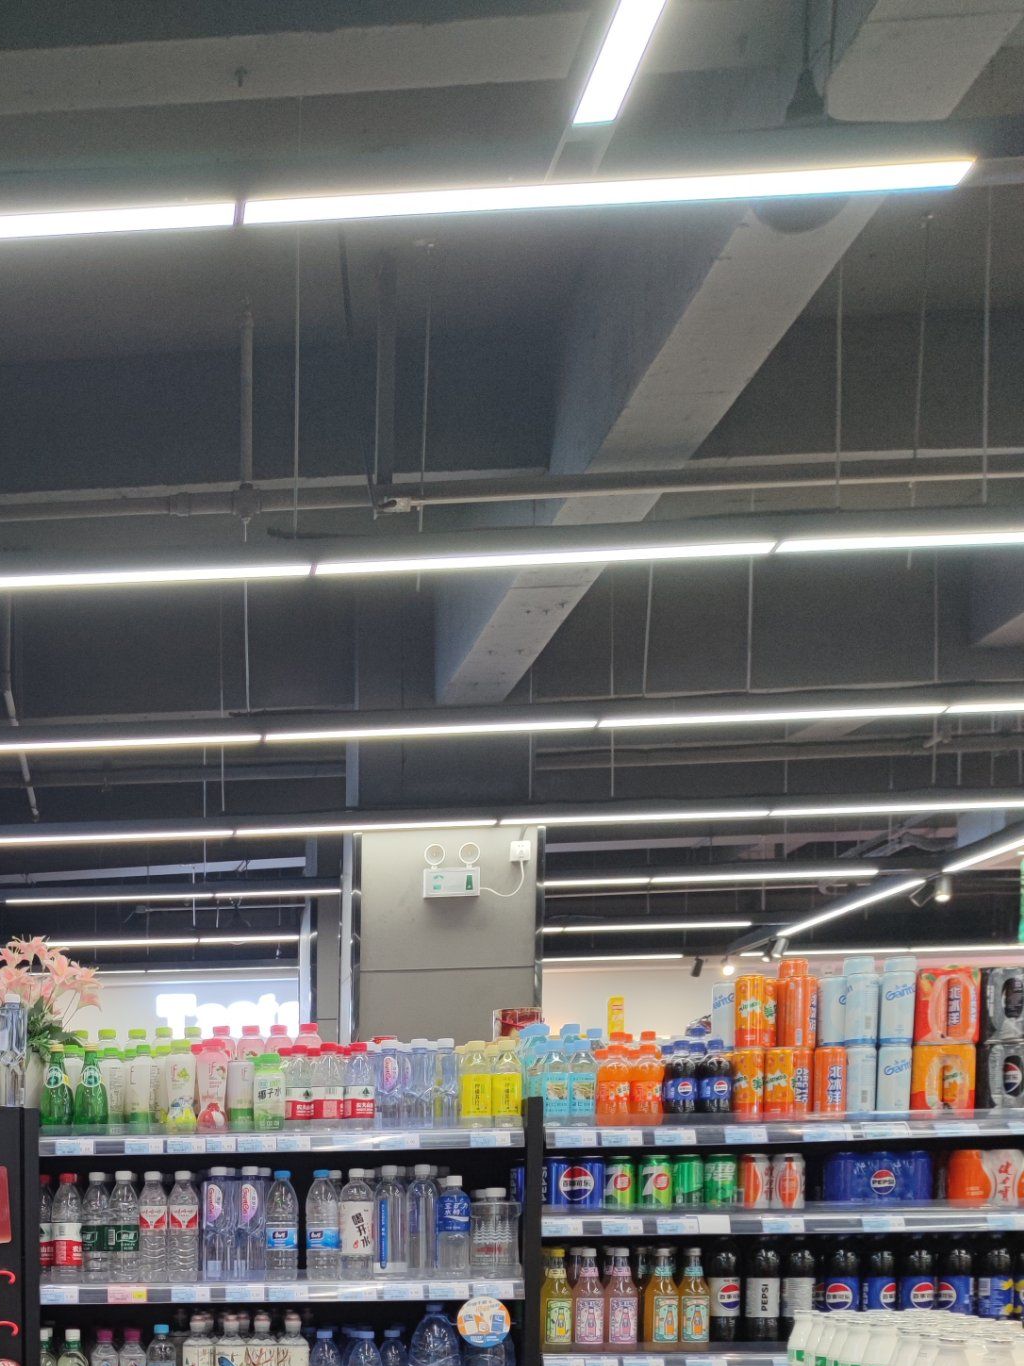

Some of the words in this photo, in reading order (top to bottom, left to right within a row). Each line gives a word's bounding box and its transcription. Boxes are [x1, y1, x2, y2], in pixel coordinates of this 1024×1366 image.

[948, 986, 961, 1025] 北冰洋
[258, 1086, 282, 1101] 椰子水
[828, 1065, 843, 1104] 北冰洋
[562, 1179, 590, 1188] 百事可乐
[352, 1212, 371, 1248] 喝开水
[761, 1283, 769, 1312] PEPSI
